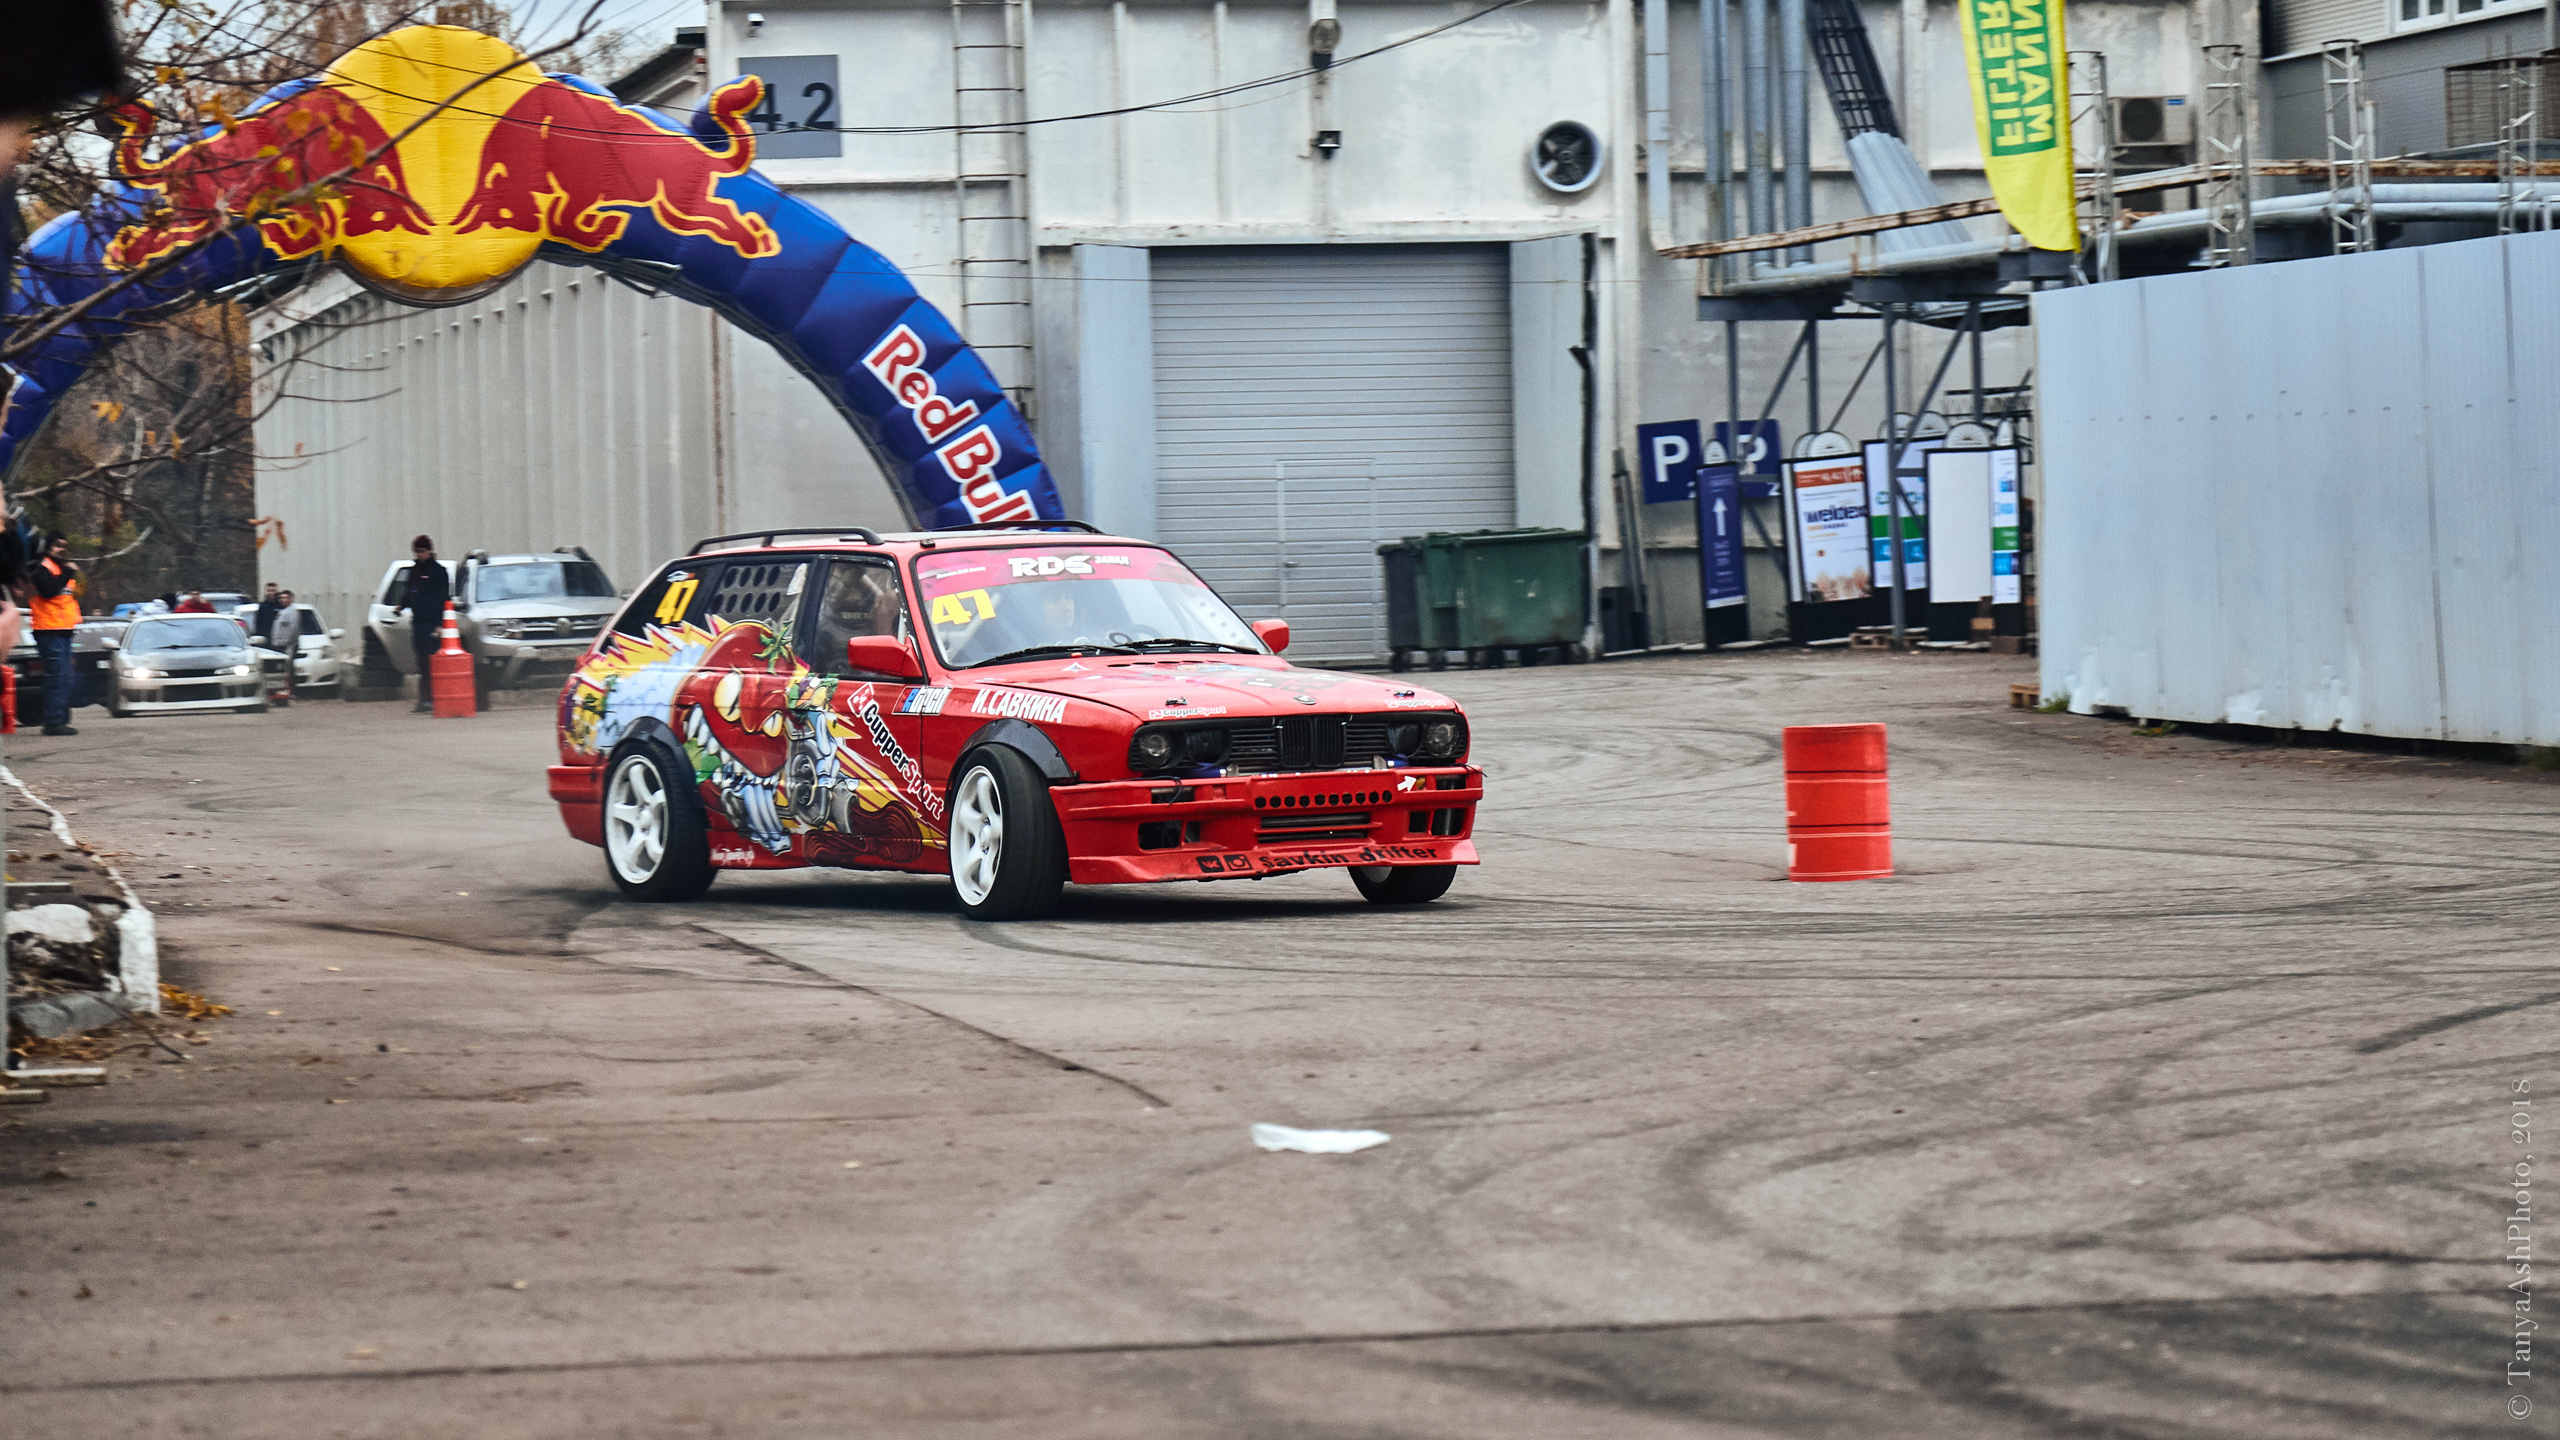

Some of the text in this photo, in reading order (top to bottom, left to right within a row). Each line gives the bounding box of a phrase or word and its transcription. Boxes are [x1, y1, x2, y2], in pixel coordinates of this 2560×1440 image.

[748, 82, 836, 131] 4.2
[863, 325, 980, 443] Red
[1652, 435, 1690, 482] P
[1008, 556, 1093, 577] RDS
[1094, 556, 1130, 565] ЗАПАД
[654, 579, 700, 624] 47
[931, 588, 996, 625] 47
[971, 689, 1069, 724] И.САВКИНА
[862, 701, 944, 820] CupperSport
